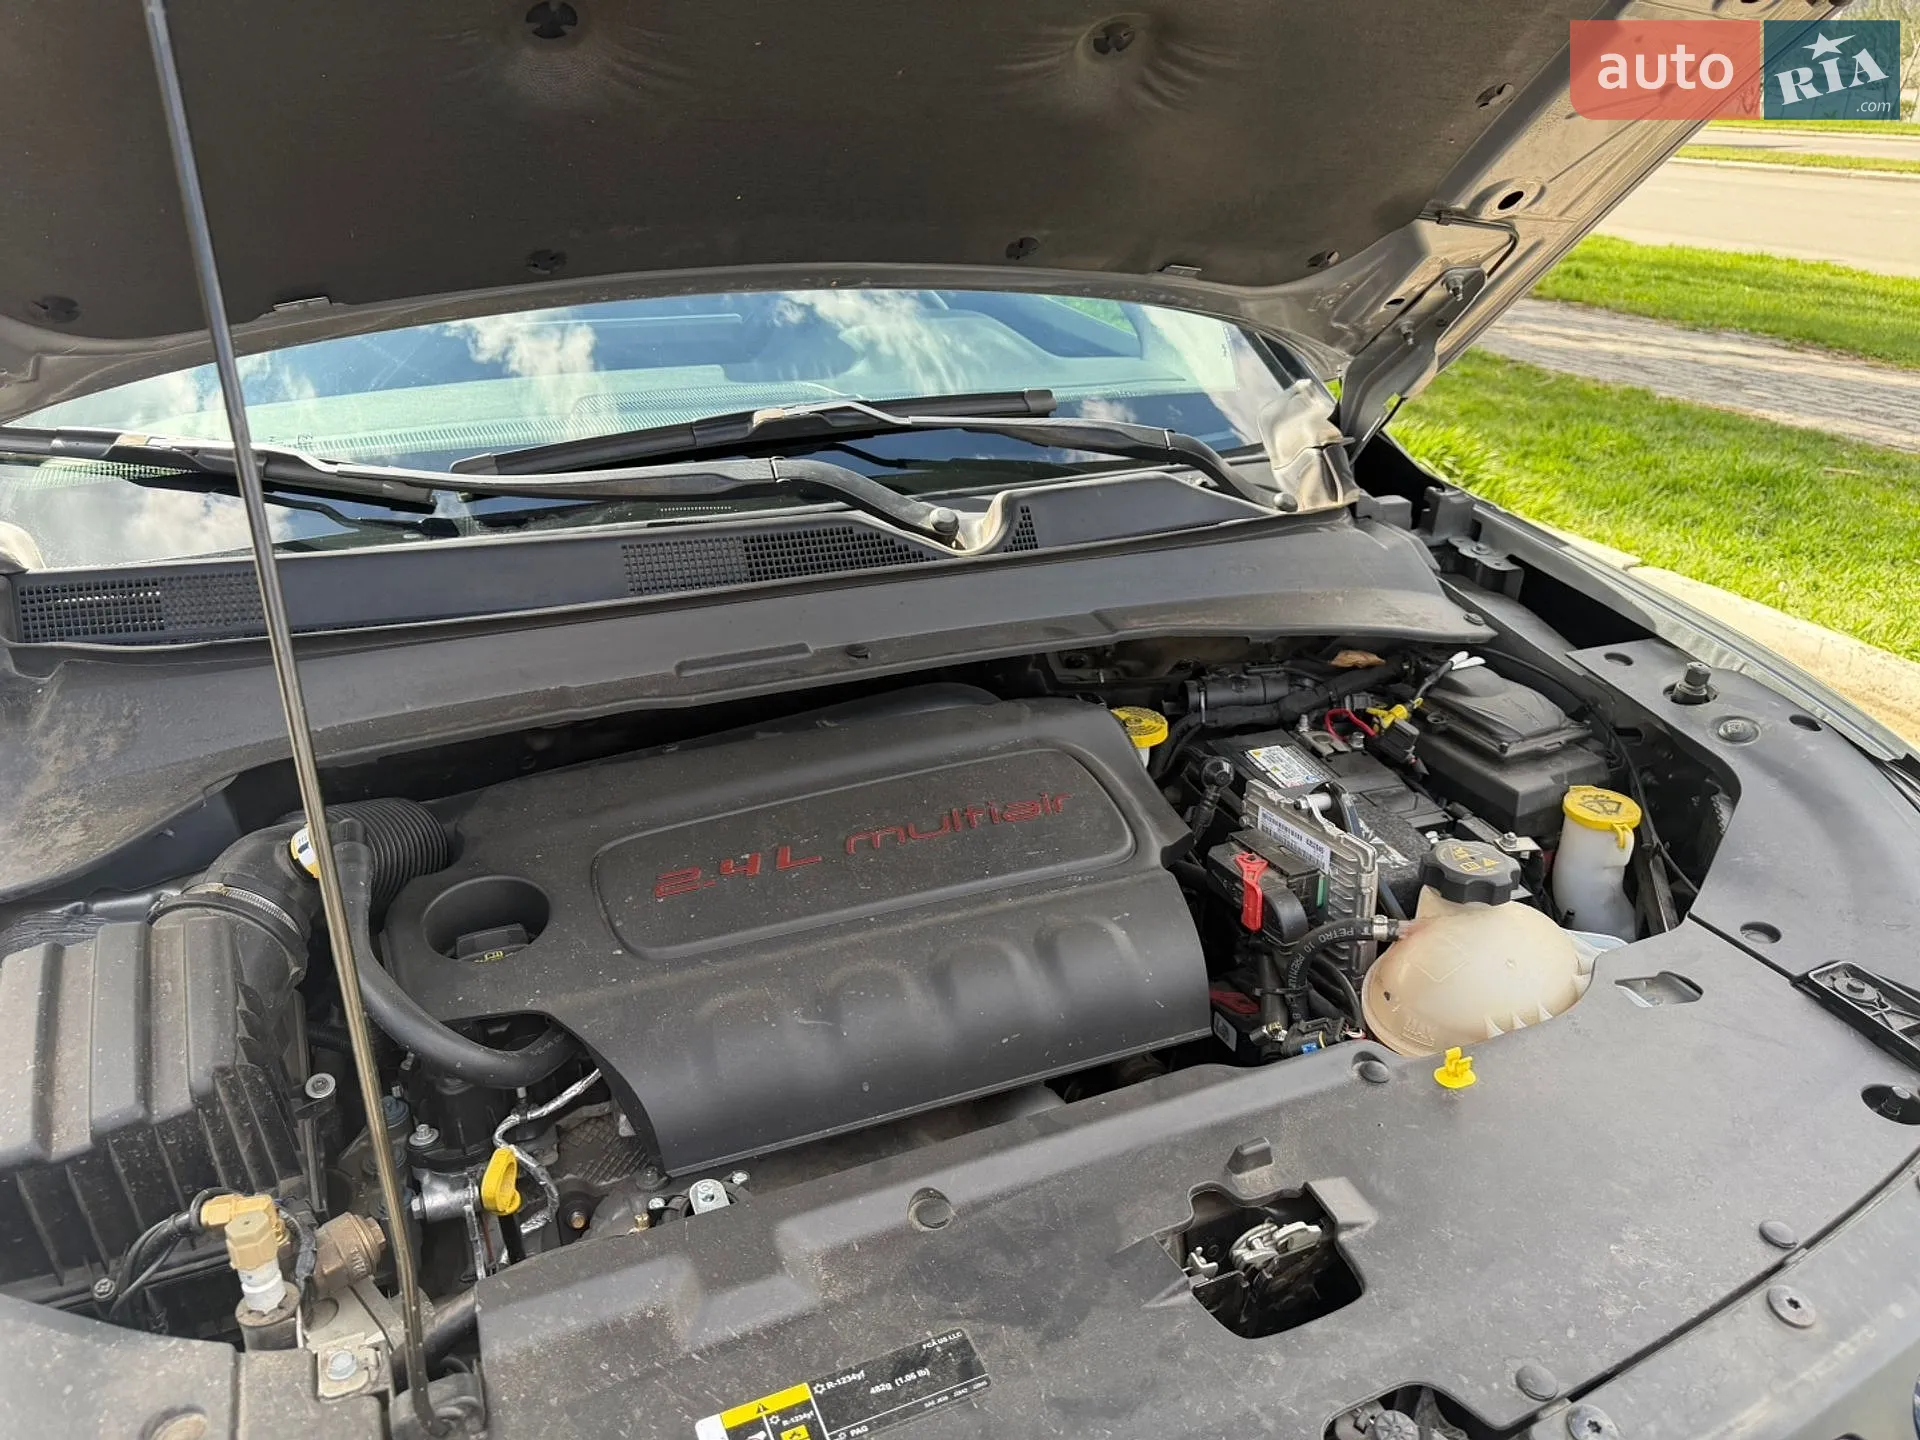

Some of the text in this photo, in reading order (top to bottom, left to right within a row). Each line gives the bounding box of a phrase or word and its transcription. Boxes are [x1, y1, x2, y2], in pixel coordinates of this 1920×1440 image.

[655, 792, 1073, 899] 2.4L multiair
[1318, 927, 1354, 943] PETRO
[825, 1370, 865, 1390] R-1234yf
[850, 1425, 868, 1437] PAG
